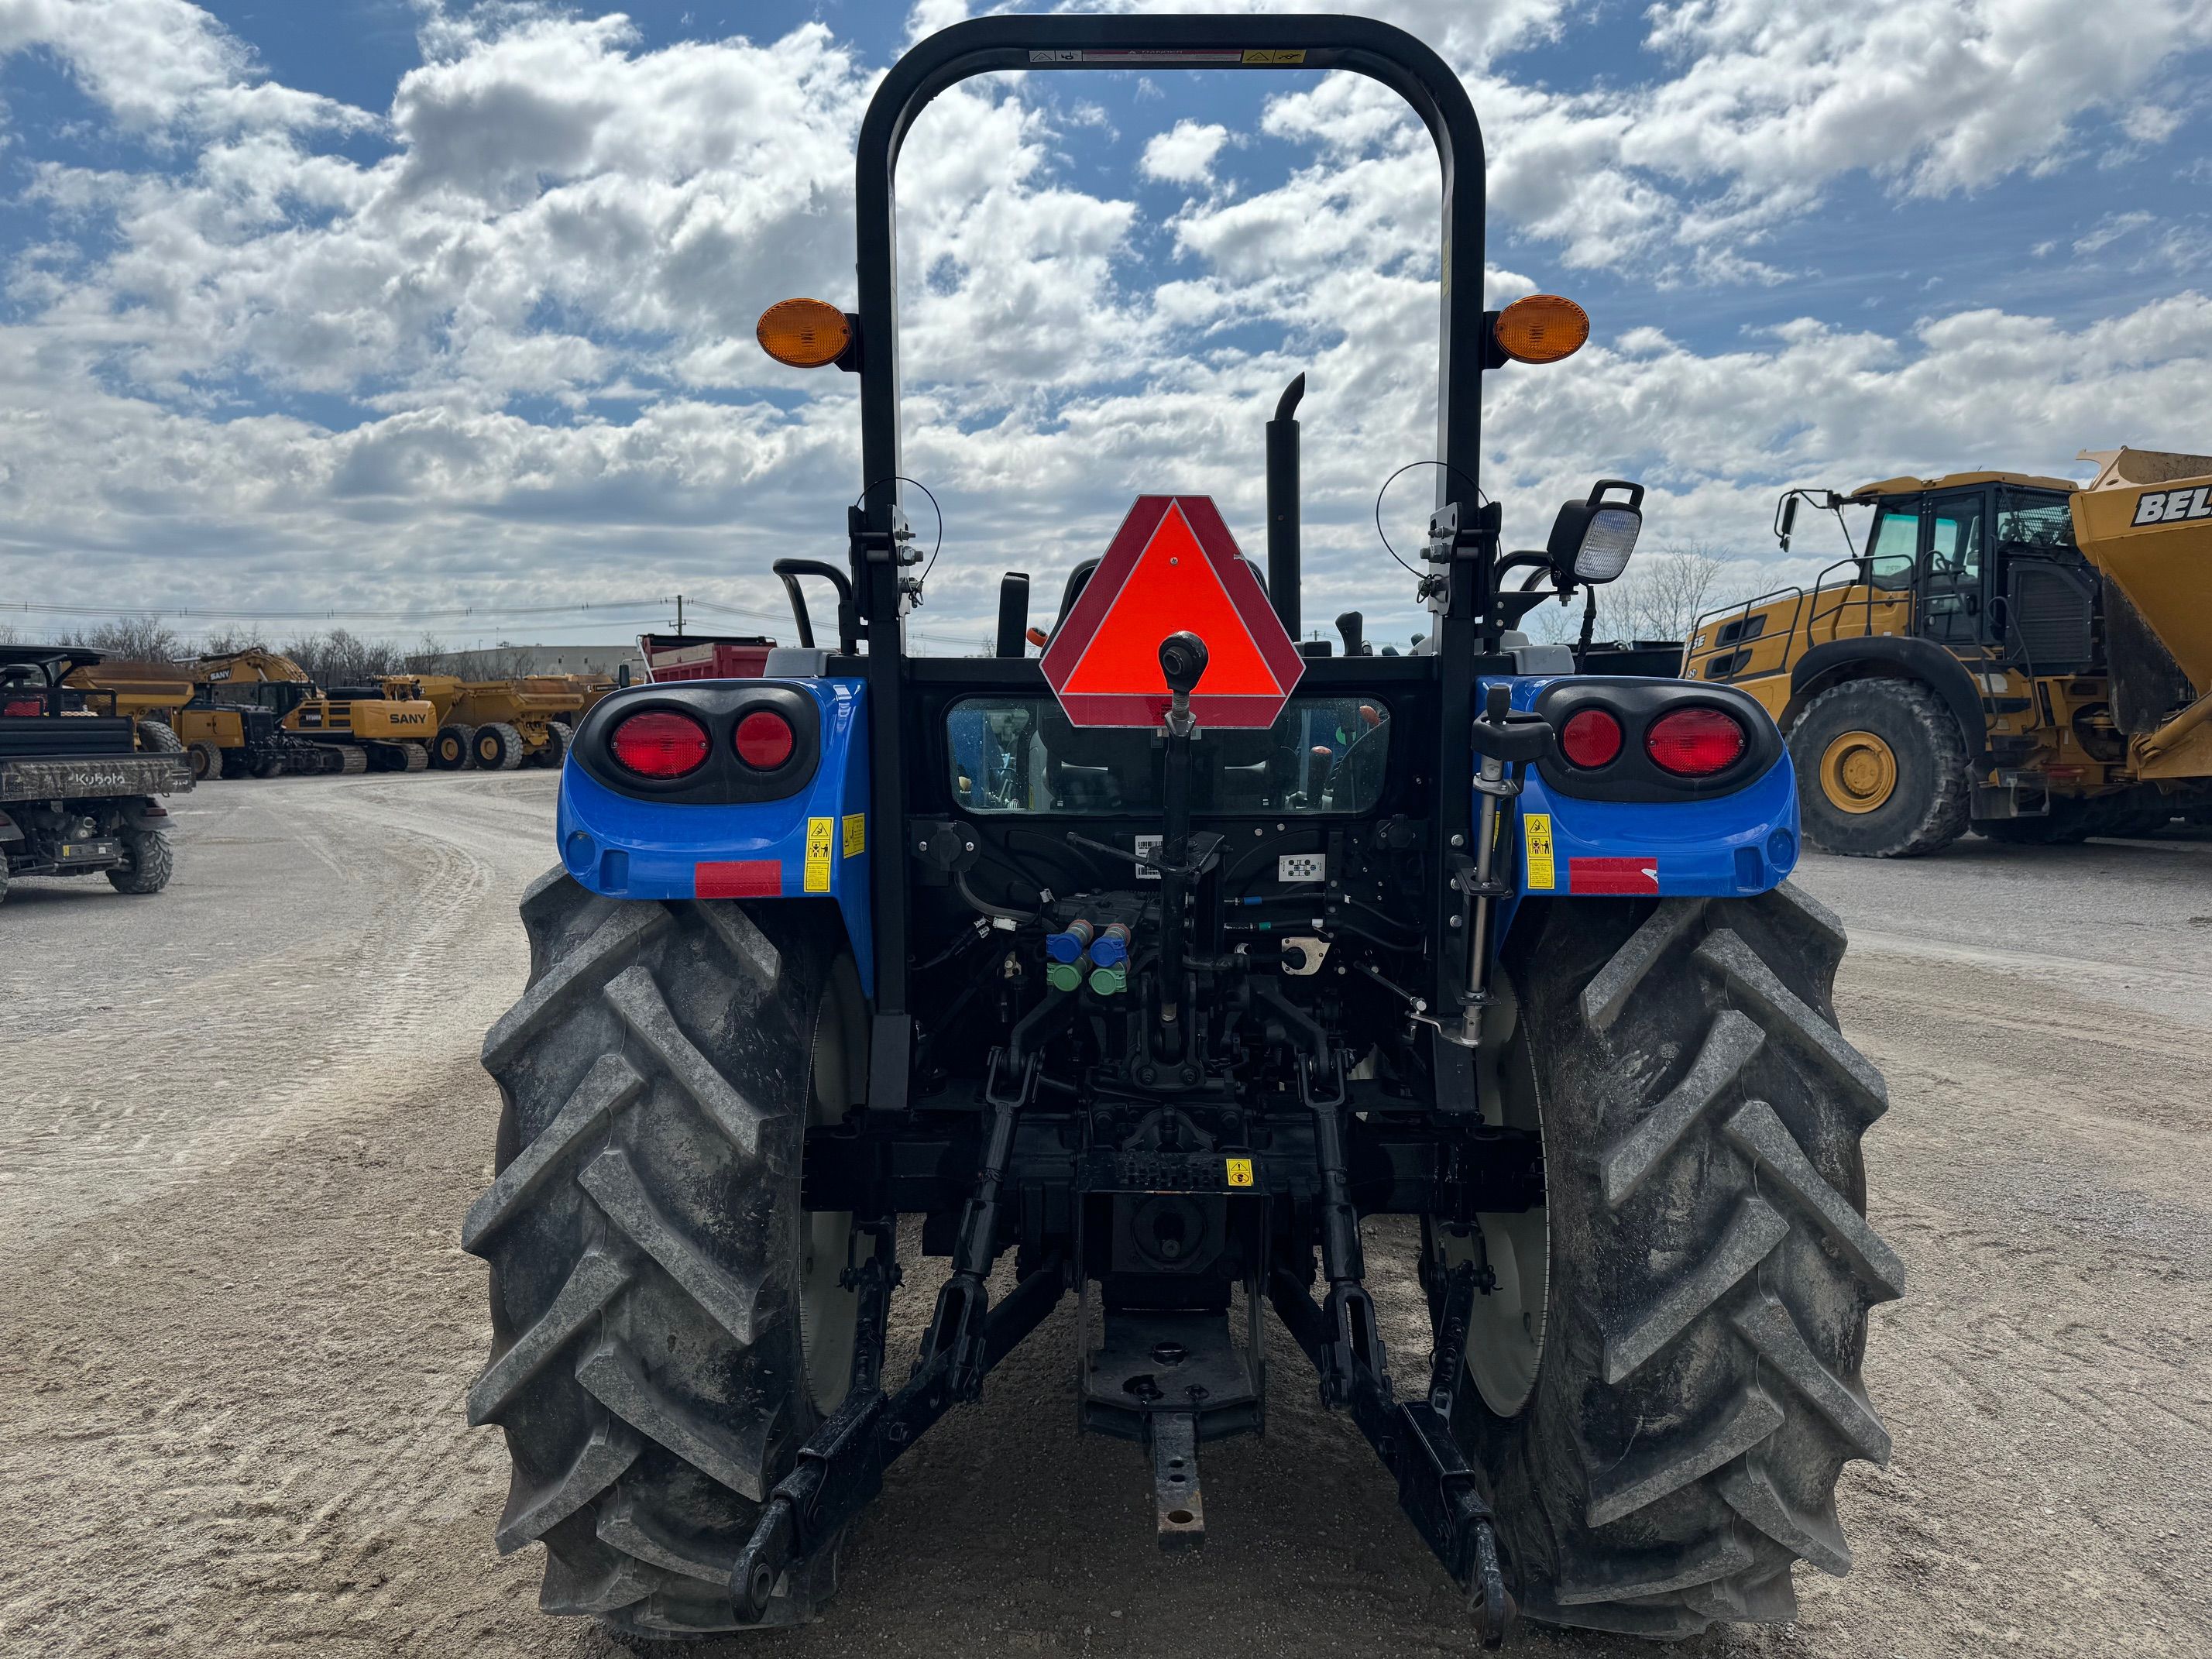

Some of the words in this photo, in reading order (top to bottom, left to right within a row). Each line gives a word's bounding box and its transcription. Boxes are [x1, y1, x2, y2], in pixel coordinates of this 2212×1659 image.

[2134, 487, 2212, 524] BEL
[210, 670, 230, 681] SANY
[390, 713, 426, 724] SANY
[75, 773, 125, 785] Kubota
